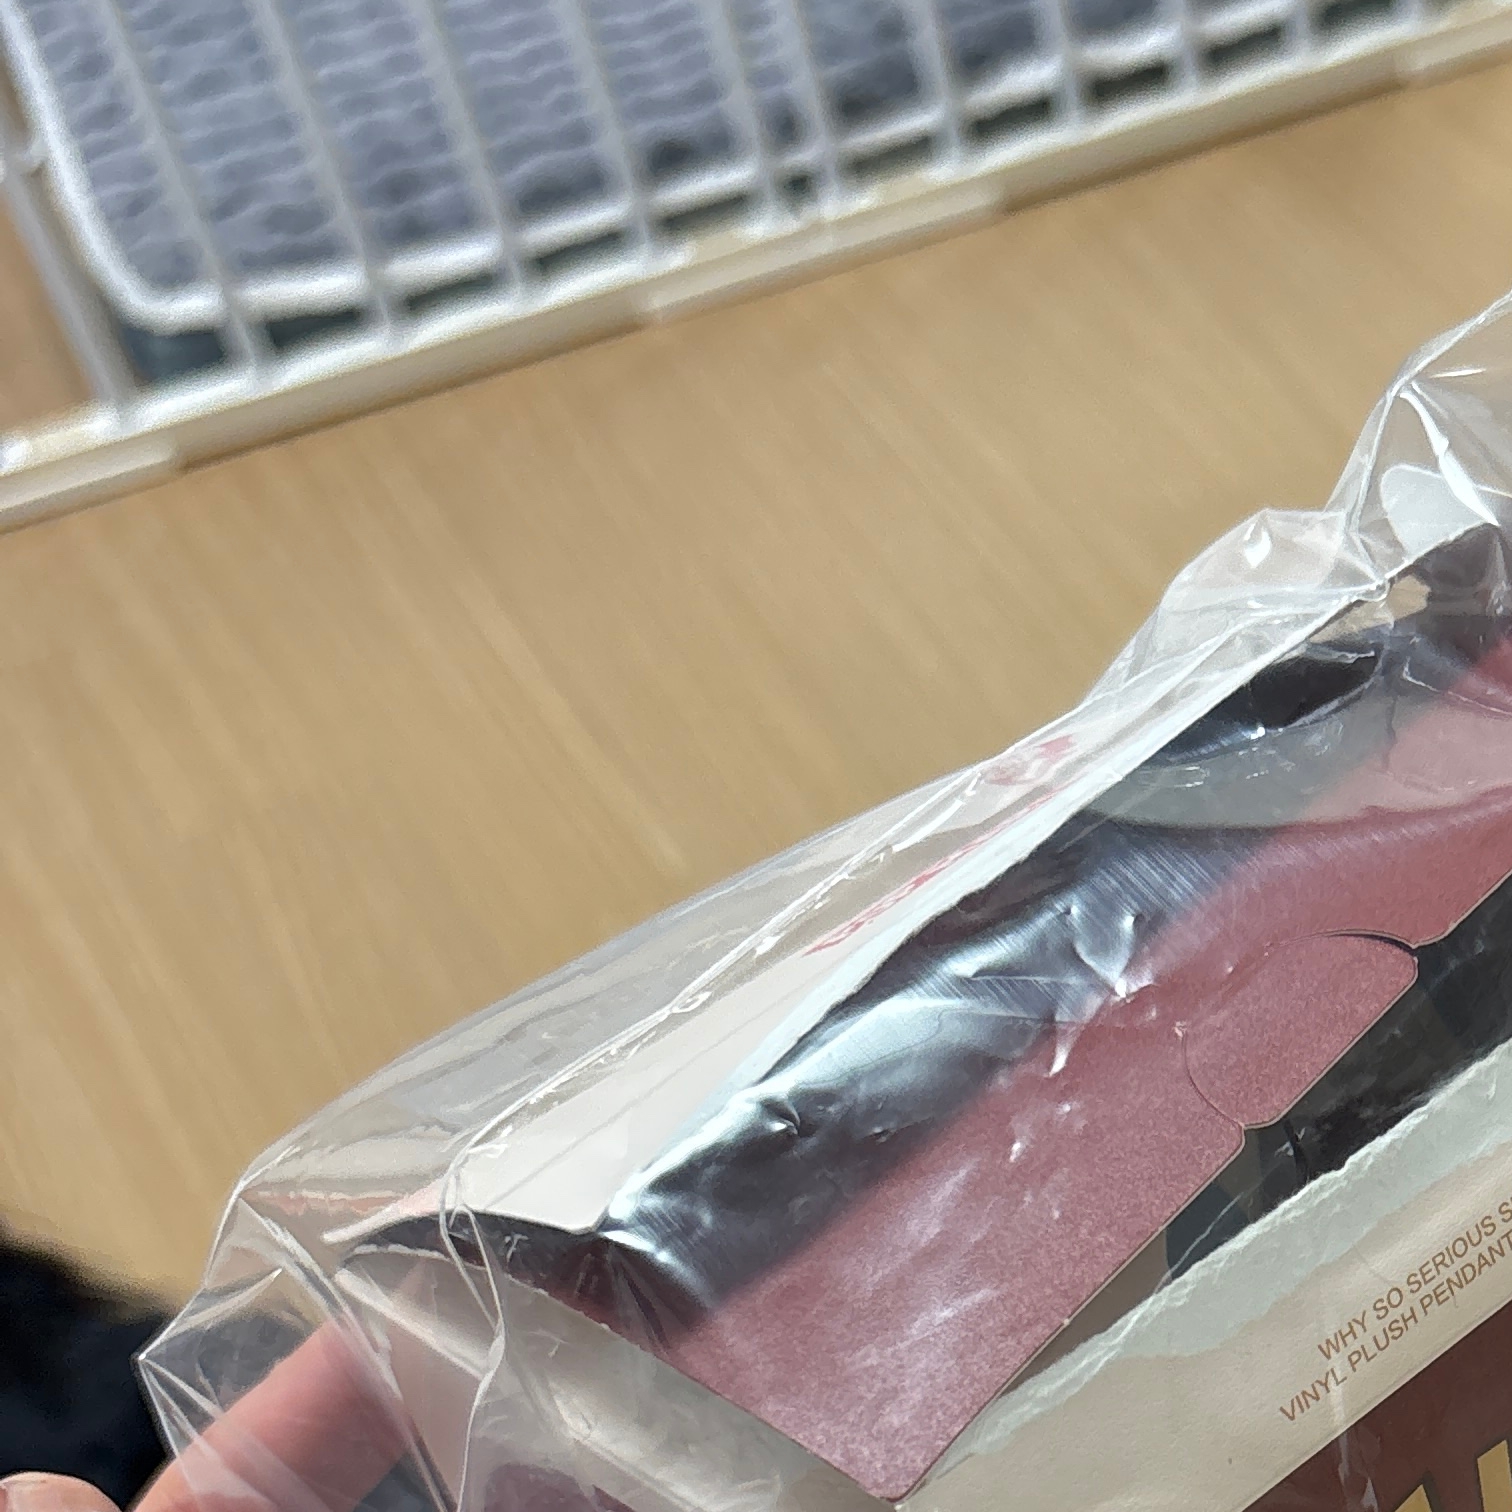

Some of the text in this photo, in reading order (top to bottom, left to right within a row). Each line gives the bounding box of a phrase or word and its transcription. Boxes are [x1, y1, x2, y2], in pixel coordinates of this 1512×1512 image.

[1317, 1310, 1368, 1361] WHY
[1373, 1286, 1405, 1321] SO
[1406, 1215, 1496, 1295] SERIOUS
[1279, 1365, 1347, 1422] VINYL
[1347, 1306, 1418, 1373] PLUSH
